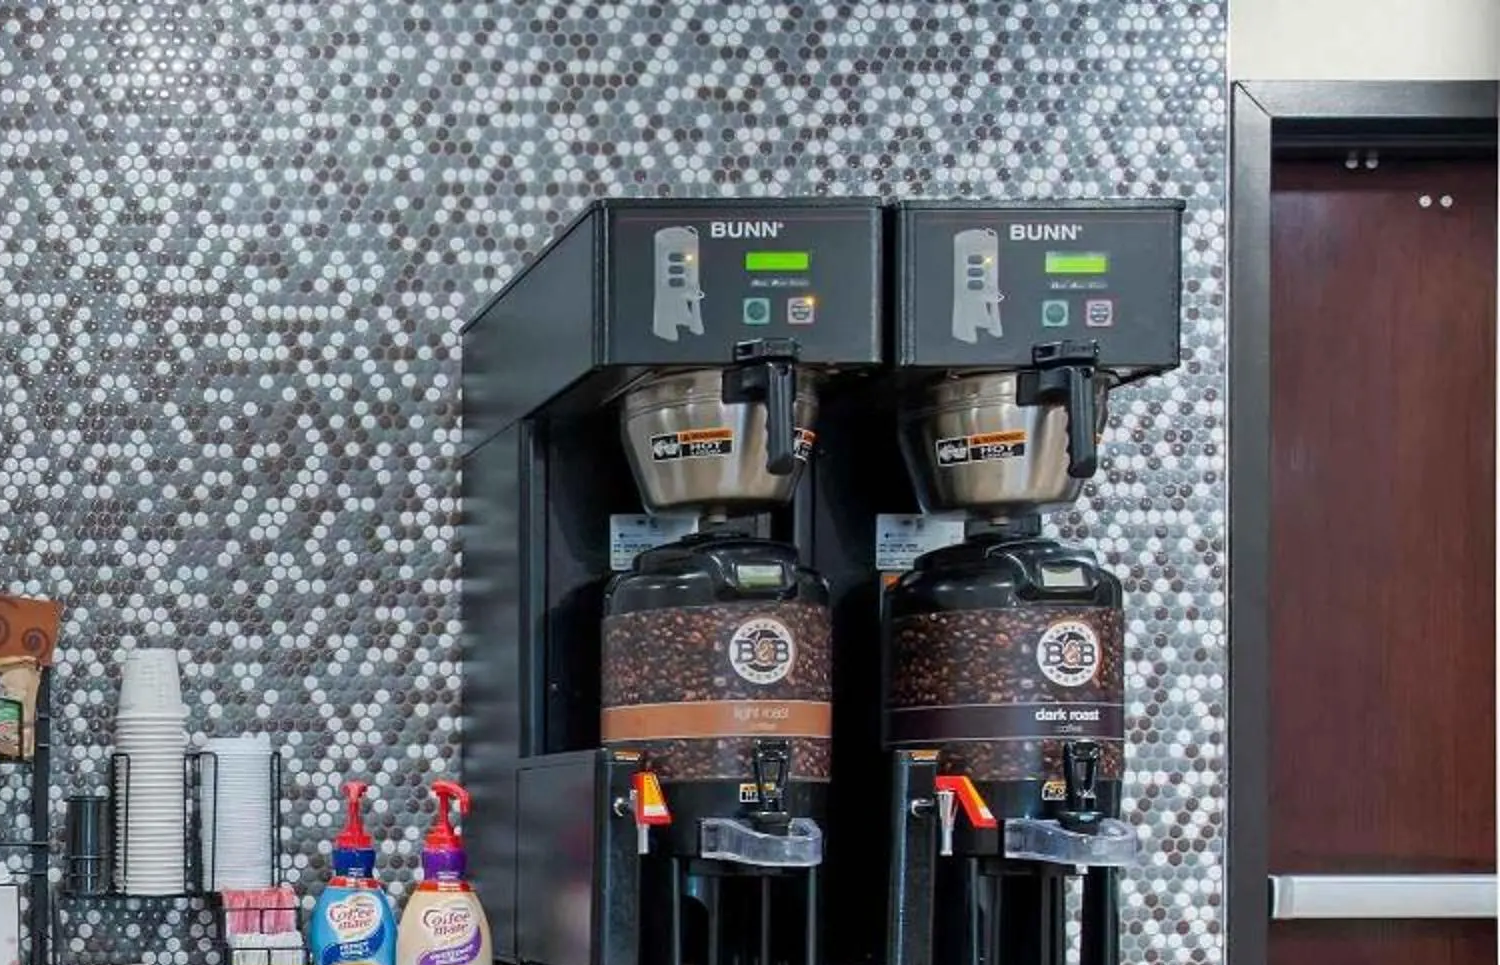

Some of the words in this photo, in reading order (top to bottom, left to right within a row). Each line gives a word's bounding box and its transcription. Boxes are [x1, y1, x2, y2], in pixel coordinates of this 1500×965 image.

[711, 221, 778, 238] BUNN
[1010, 223, 1077, 240] BUNN
[1035, 708, 1067, 721] dark
[1069, 708, 1100, 721] roast
